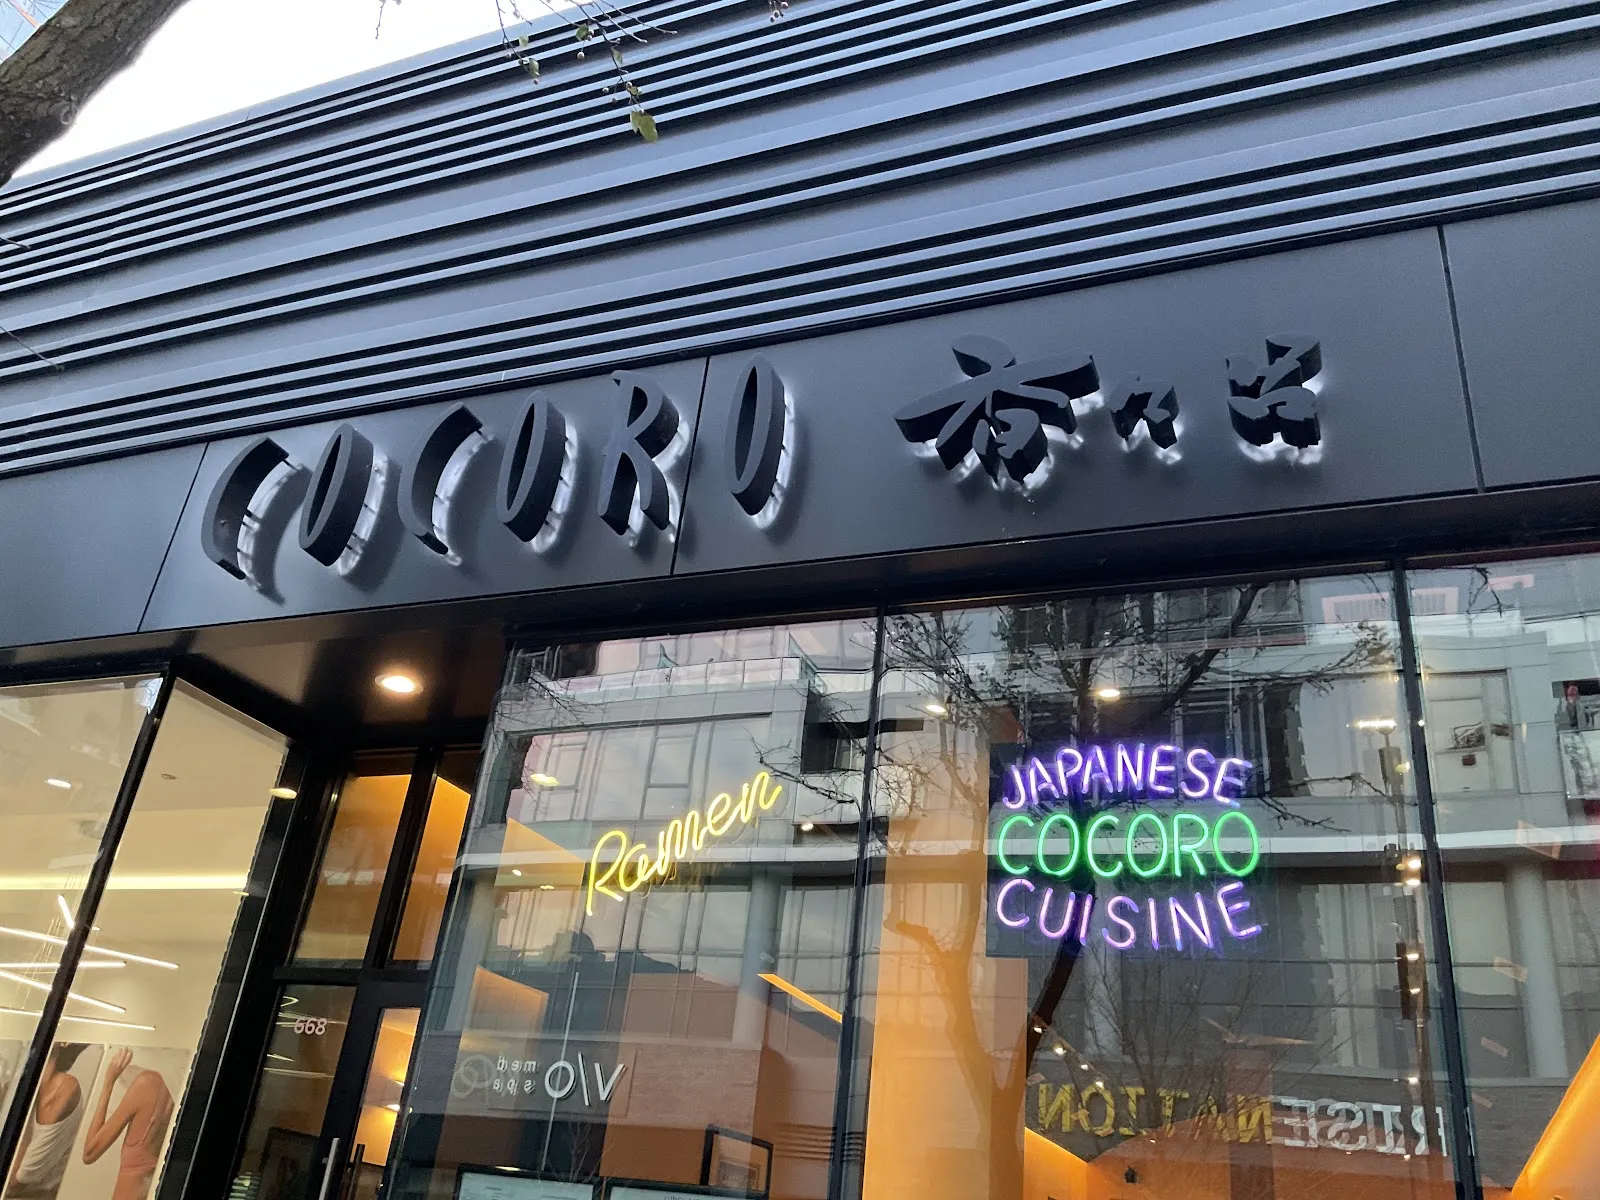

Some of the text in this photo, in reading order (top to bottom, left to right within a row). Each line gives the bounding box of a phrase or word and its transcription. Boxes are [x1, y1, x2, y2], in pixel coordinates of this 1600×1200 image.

[201, 354, 792, 584] COCORO
[1002, 742, 1254, 809] JAPANESE
[585, 771, 783, 916] Ramen
[996, 811, 1260, 878] COCORO
[996, 878, 1263, 951] CUISINE
[294, 1017, 328, 1036] 668
